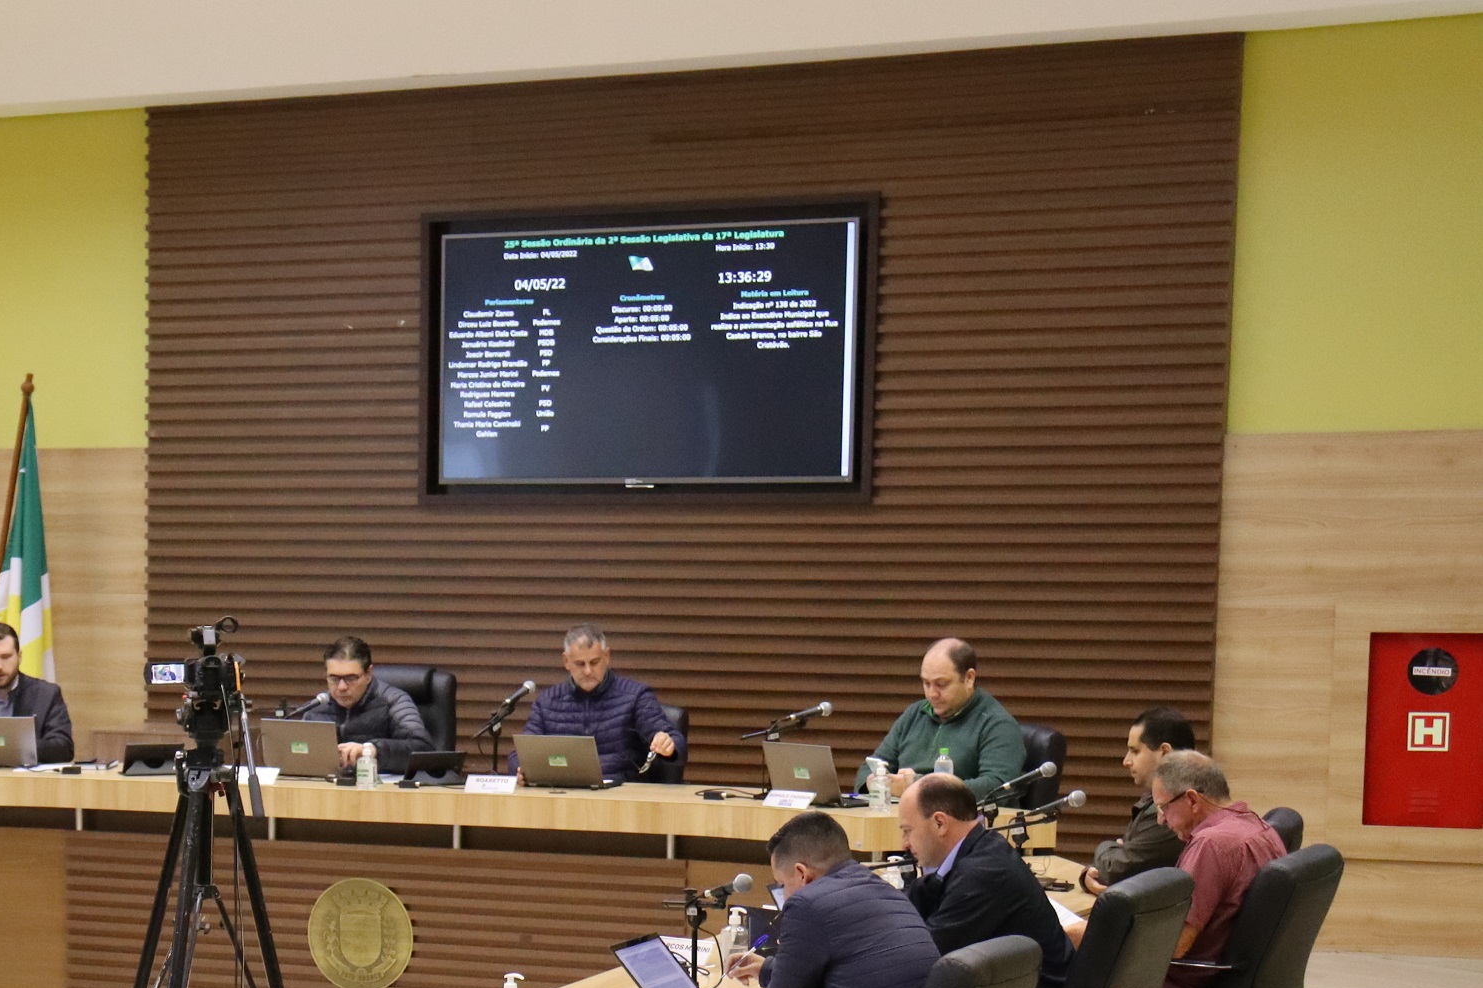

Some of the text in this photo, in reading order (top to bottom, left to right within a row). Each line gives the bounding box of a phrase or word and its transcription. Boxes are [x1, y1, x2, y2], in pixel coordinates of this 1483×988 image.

[505, 230, 784, 248] 25ª Sessão Ordinária da 2ª Sessão Legislativa da 17ª Legislatura
[755, 242, 775, 250] 13:30
[540, 250, 577, 258] 04/05/2022
[718, 270, 772, 283] 13:36:29
[514, 278, 566, 291] 04/05/22
[642, 304, 673, 312] 00:05:00
[733, 301, 764, 310] Indicação
[799, 299, 817, 307] 2022
[614, 314, 670, 324] Aparte: 00:05:00
[720, 312, 741, 320] Indica
[751, 311, 783, 319] Executivo
[784, 310, 815, 318] Municipal
[825, 319, 838, 327] Rua
[596, 326, 622, 334] Questão
[638, 334, 659, 342] Finais:
[660, 333, 691, 341] 00:05:00
[751, 331, 776, 339] Branco,
[1414, 667, 1449, 675] INCÊNDIO
[1414, 719, 1443, 745] H
